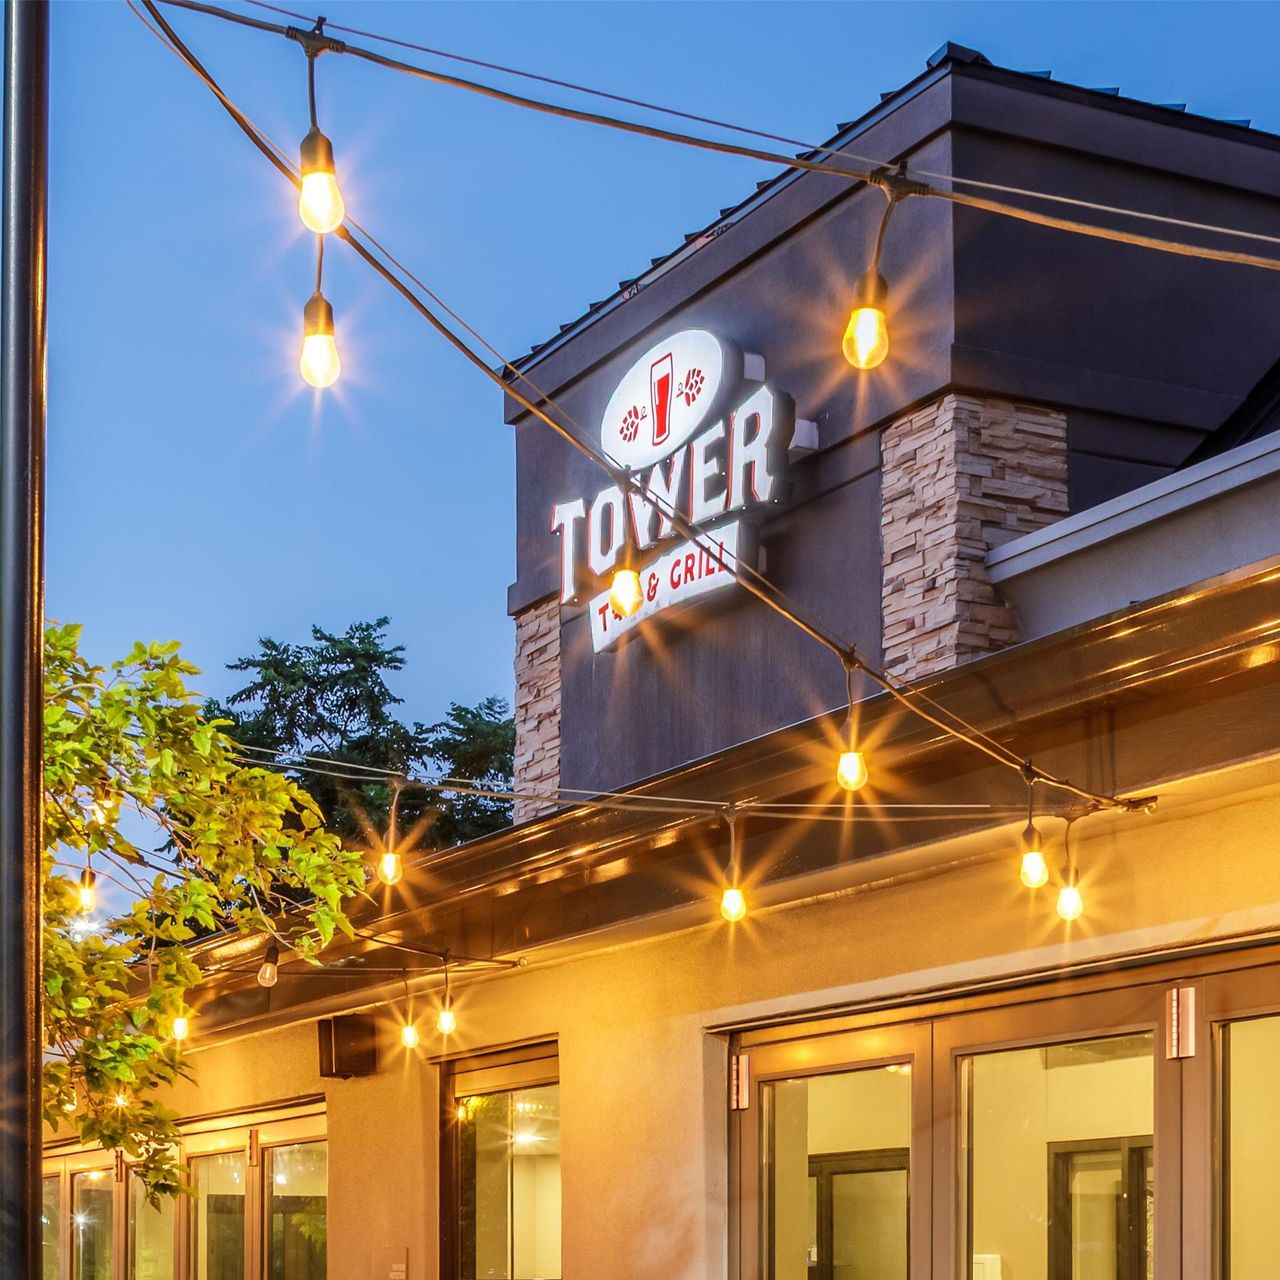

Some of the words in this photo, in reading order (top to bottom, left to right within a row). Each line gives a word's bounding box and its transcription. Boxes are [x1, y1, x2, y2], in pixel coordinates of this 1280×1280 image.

[550, 386, 774, 605] TOWER
[646, 571, 659, 601] &
[669, 540, 728, 590] GRILL
